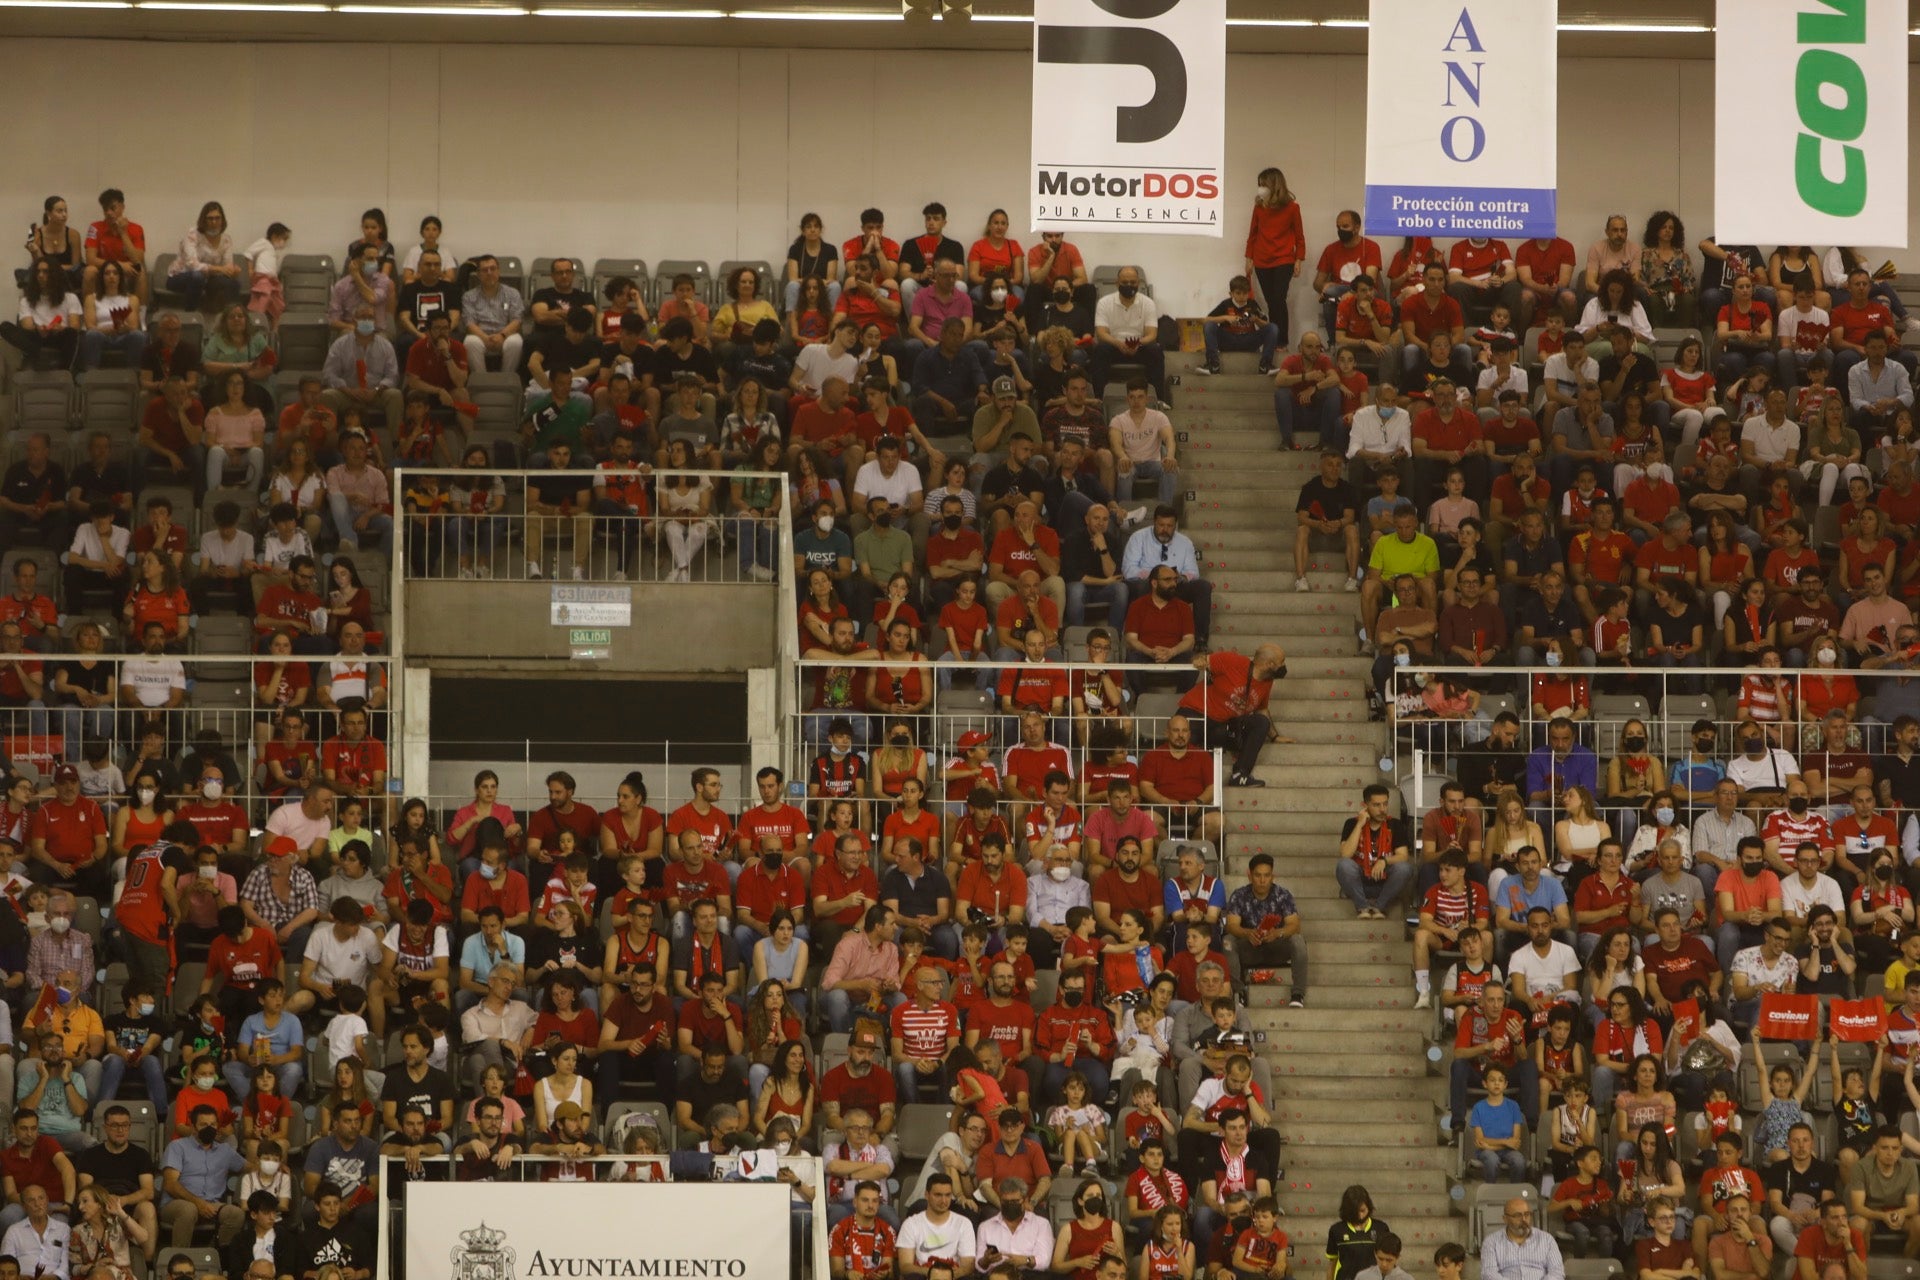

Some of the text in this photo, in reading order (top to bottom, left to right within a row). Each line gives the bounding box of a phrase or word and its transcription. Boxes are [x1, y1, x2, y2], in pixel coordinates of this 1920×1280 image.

[1038, 171, 1219, 199] MotorDOS
[1392, 195, 1530, 213] Protección contra
[1039, 205, 1096, 218] PURA
[1397, 214, 1524, 230] robo e incendios
[558, 589, 575, 600] C3
[573, 632, 608, 642] SALIDA
[963, 984, 972, 995] 12
[525, 1249, 746, 1277] AYUNTAMIENTO
